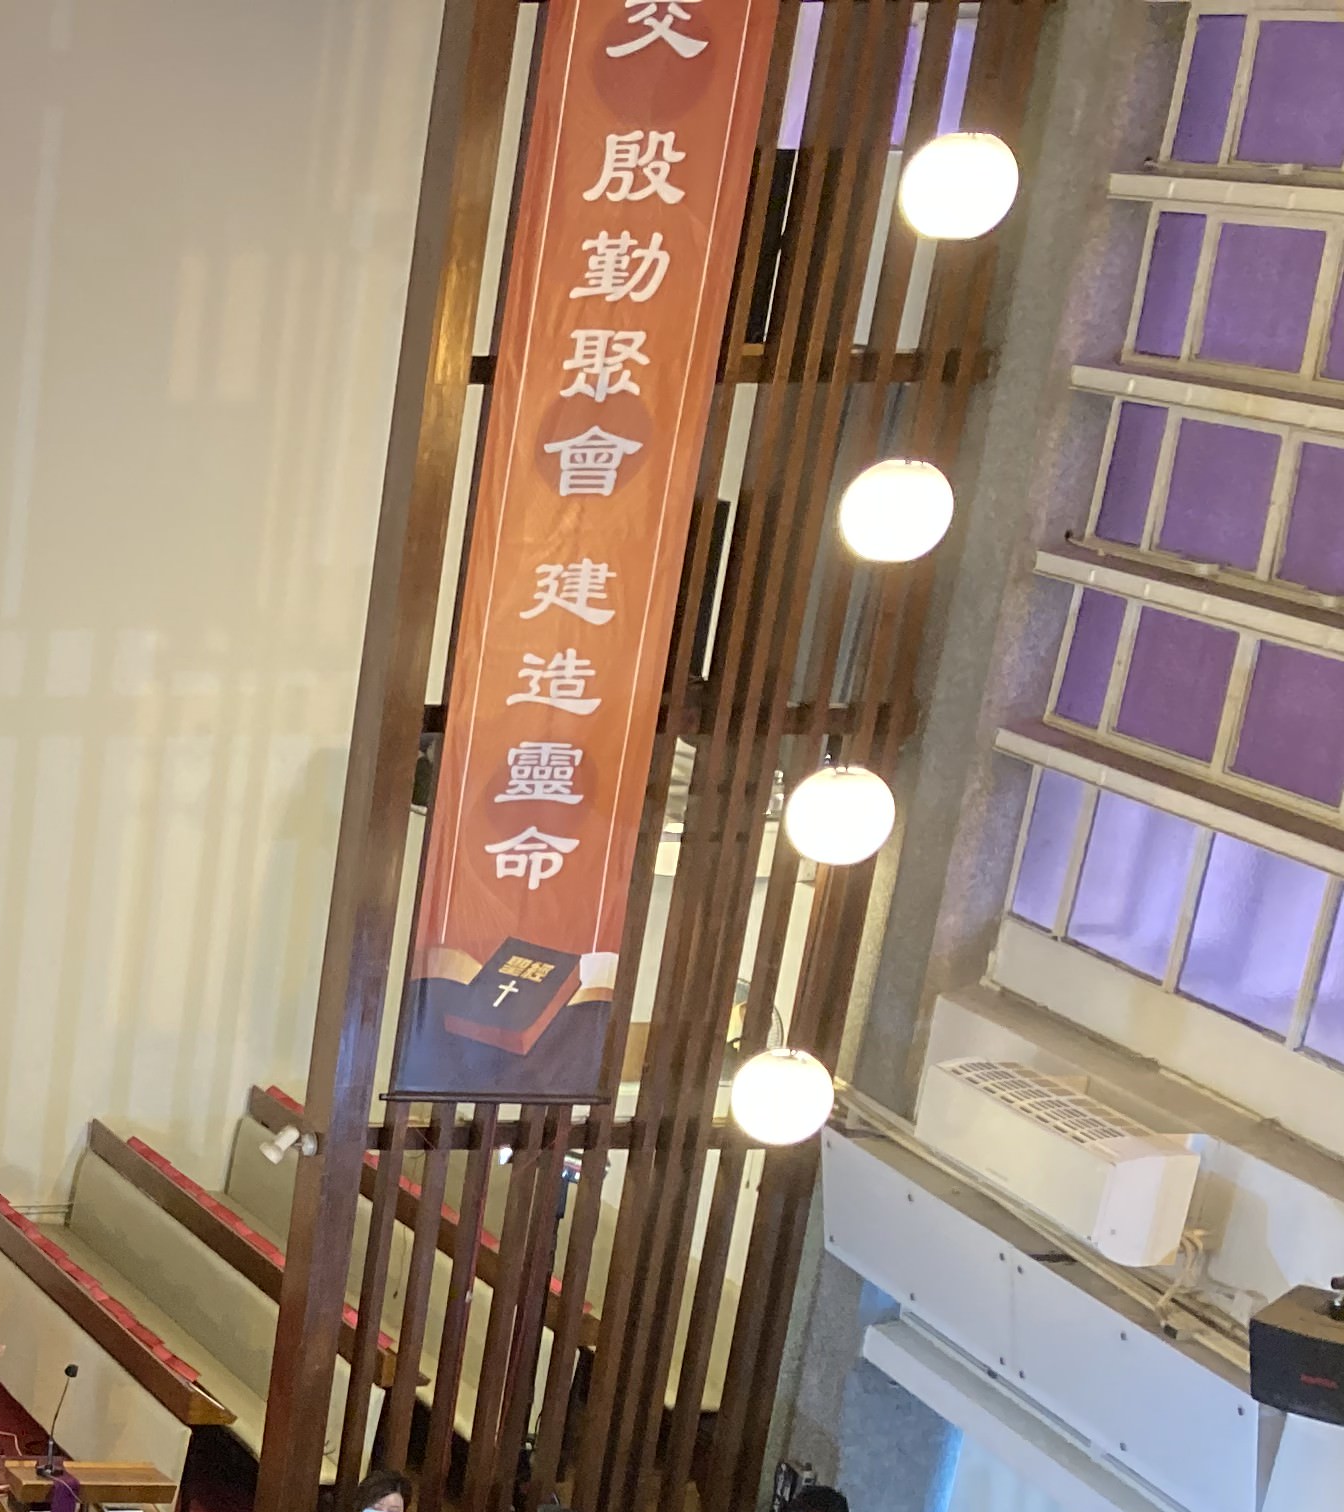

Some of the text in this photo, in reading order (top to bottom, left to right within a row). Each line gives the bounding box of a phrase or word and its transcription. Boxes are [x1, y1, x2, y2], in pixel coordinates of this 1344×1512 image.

[542, 129, 687, 497] 殷勤聚會
[484, 557, 618, 890] 建造靈命
